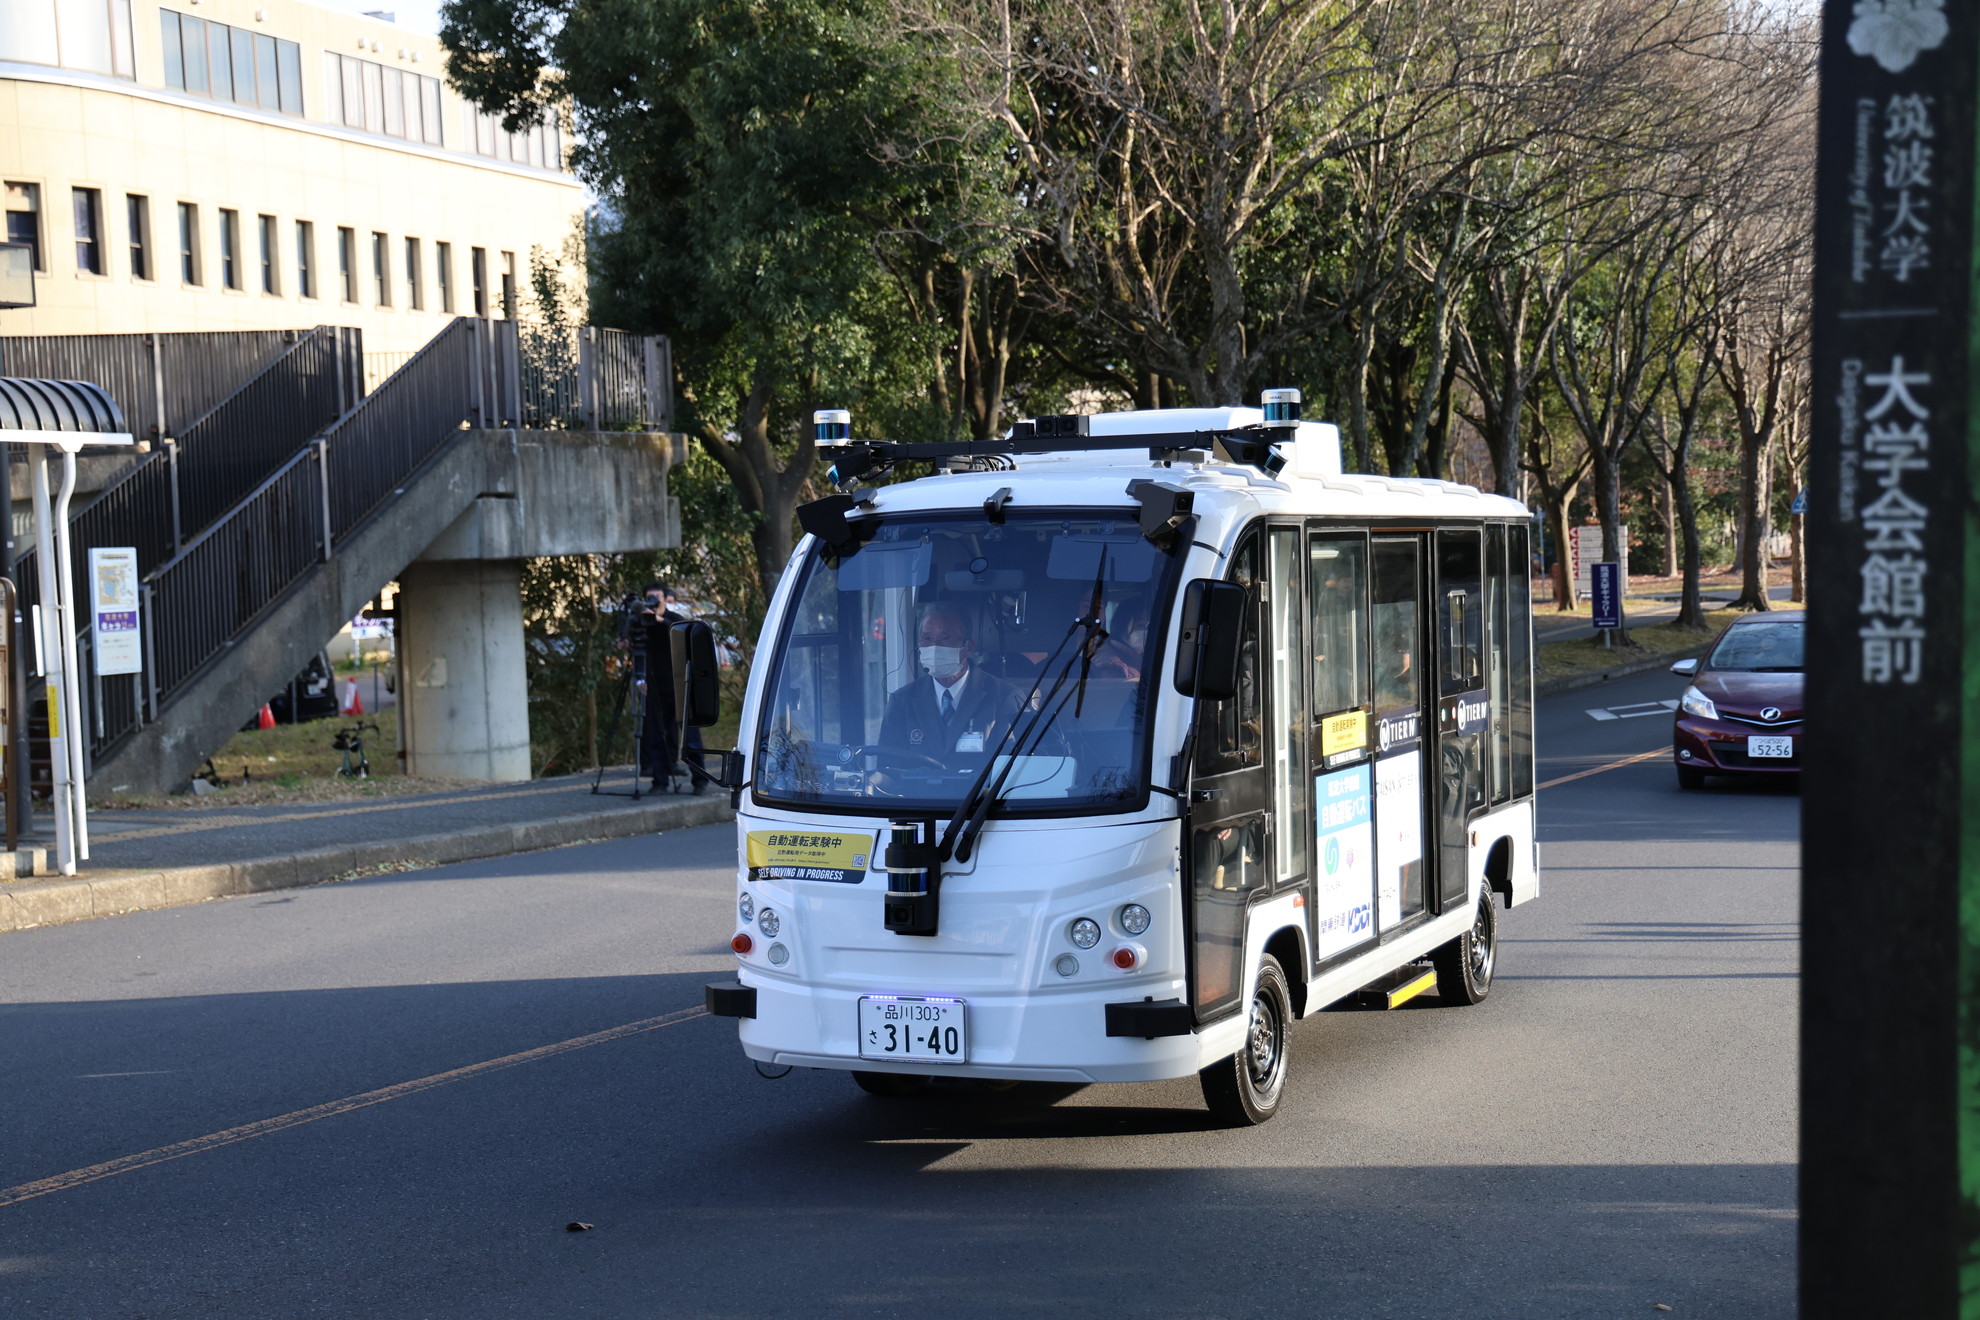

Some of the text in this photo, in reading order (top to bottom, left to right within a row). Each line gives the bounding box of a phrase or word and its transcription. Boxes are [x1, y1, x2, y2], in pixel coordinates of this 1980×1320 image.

[1849, 98, 1876, 284] University of Tsukuba
[1881, 92, 1936, 284] 筑波大学
[1837, 358, 1863, 522] Daigaku Kaikan
[1857, 354, 1932, 685] 大学会館前
[1466, 703, 1480, 722] TIER
[1390, 720, 1408, 742] TIER
[1758, 745, 1790, 756] 52-56
[767, 834, 843, 849] 自動運転実験中
[770, 867, 796, 878] DRIVING
[796, 868, 804, 878] IN
[805, 869, 844, 881] PROGRESS
[869, 1023, 959, 1055] さ 31-40
